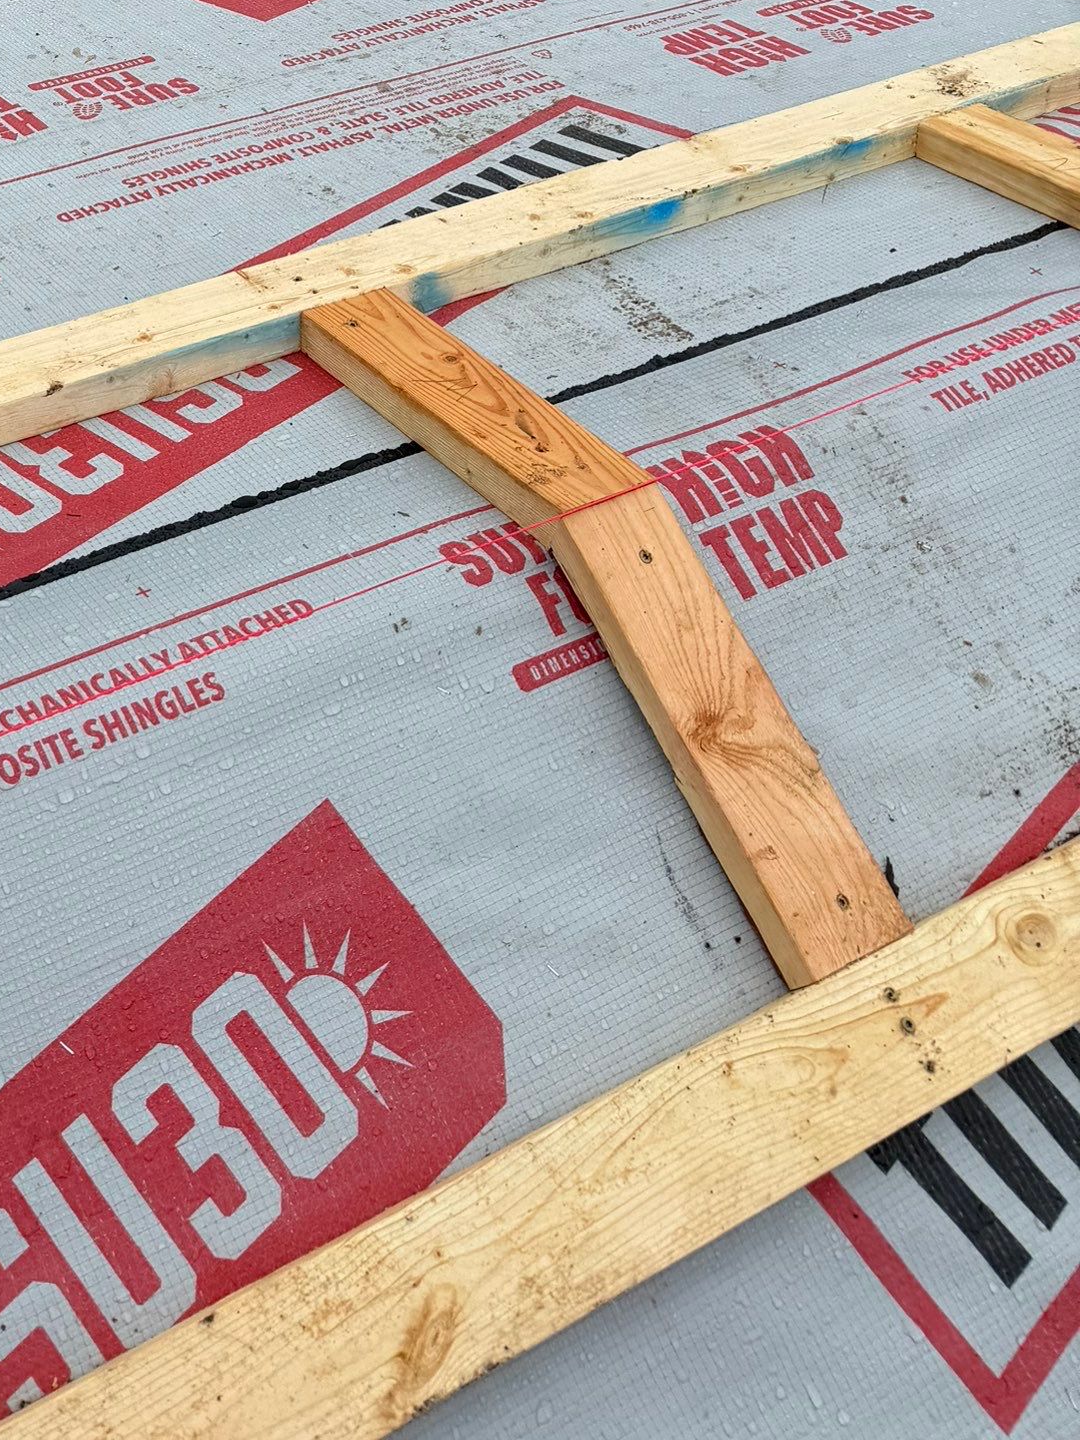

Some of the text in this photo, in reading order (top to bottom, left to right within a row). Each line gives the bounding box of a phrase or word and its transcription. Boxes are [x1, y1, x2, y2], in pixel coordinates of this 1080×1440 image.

[331, 16, 412, 42] SHINGLES
[785, 0, 874, 30] FOOT
[841, 5, 935, 37] SURE
[364, 14, 480, 56] MECHANICALLY
[658, 19, 767, 56] TEMP
[280, 41, 366, 69] ATTACHED
[685, 35, 813, 78] HIGH
[52, 71, 146, 105] FOOT
[101, 77, 200, 111] SURE
[530, 79, 566, 94] FOR
[211, 132, 316, 165] COMPOSITE
[120, 156, 213, 190] SHINGLES
[155, 152, 296, 197] MECHANICALLY
[56, 188, 154, 223] ATTACHED
[901, 359, 956, 383] FOR
[943, 343, 995, 367] USE
[980, 318, 1062, 351] UNDER
[928, 342, 1077, 413] TILE, ADHERED
[647, 424, 816, 525] HIGH
[699, 488, 849, 602] TEMP
[176, 598, 315, 662] ATTACHED
[88, 670, 227, 751] SHINGLES
